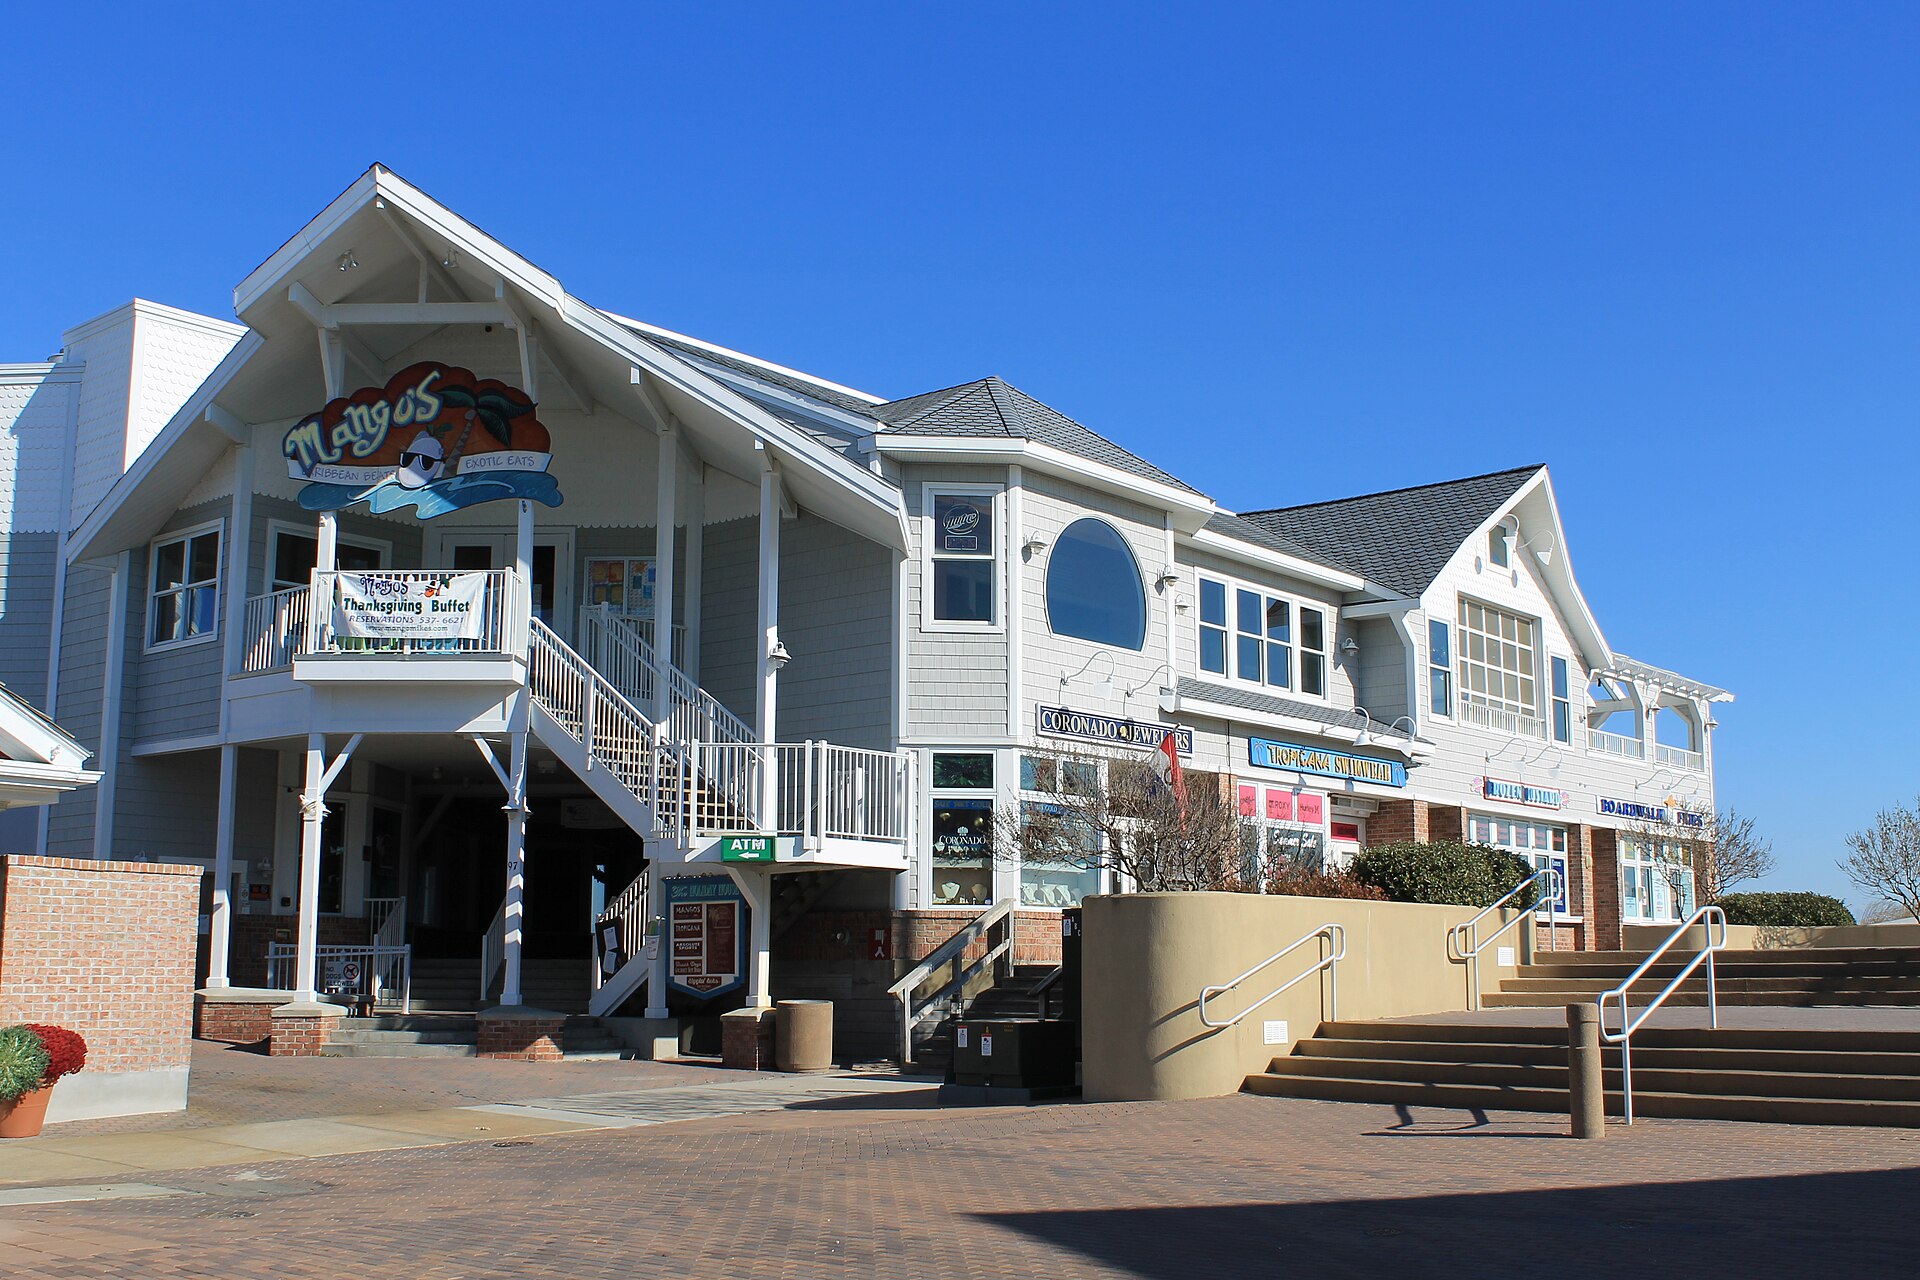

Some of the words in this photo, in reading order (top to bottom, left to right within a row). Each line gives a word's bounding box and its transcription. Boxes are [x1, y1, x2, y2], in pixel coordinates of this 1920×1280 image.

[465, 457, 503, 468] EXOTIC
[507, 455, 535, 466] EATS
[302, 467, 358, 480] RIBBEAN
[343, 597, 422, 614] Thanksgiving
[431, 599, 470, 612] Buffet
[349, 615, 414, 624] RESERVATIONS
[1041, 710, 1118, 739] CORONADO
[1126, 724, 1189, 749] JEWELRS
[1267, 745, 1330, 771] TROPICANA
[1274, 800, 1291, 810] ROXY
[1600, 799, 1666, 821] BOARDWALK
[730, 838, 766, 850] ATM
[675, 924, 701, 932] TROPICANA
